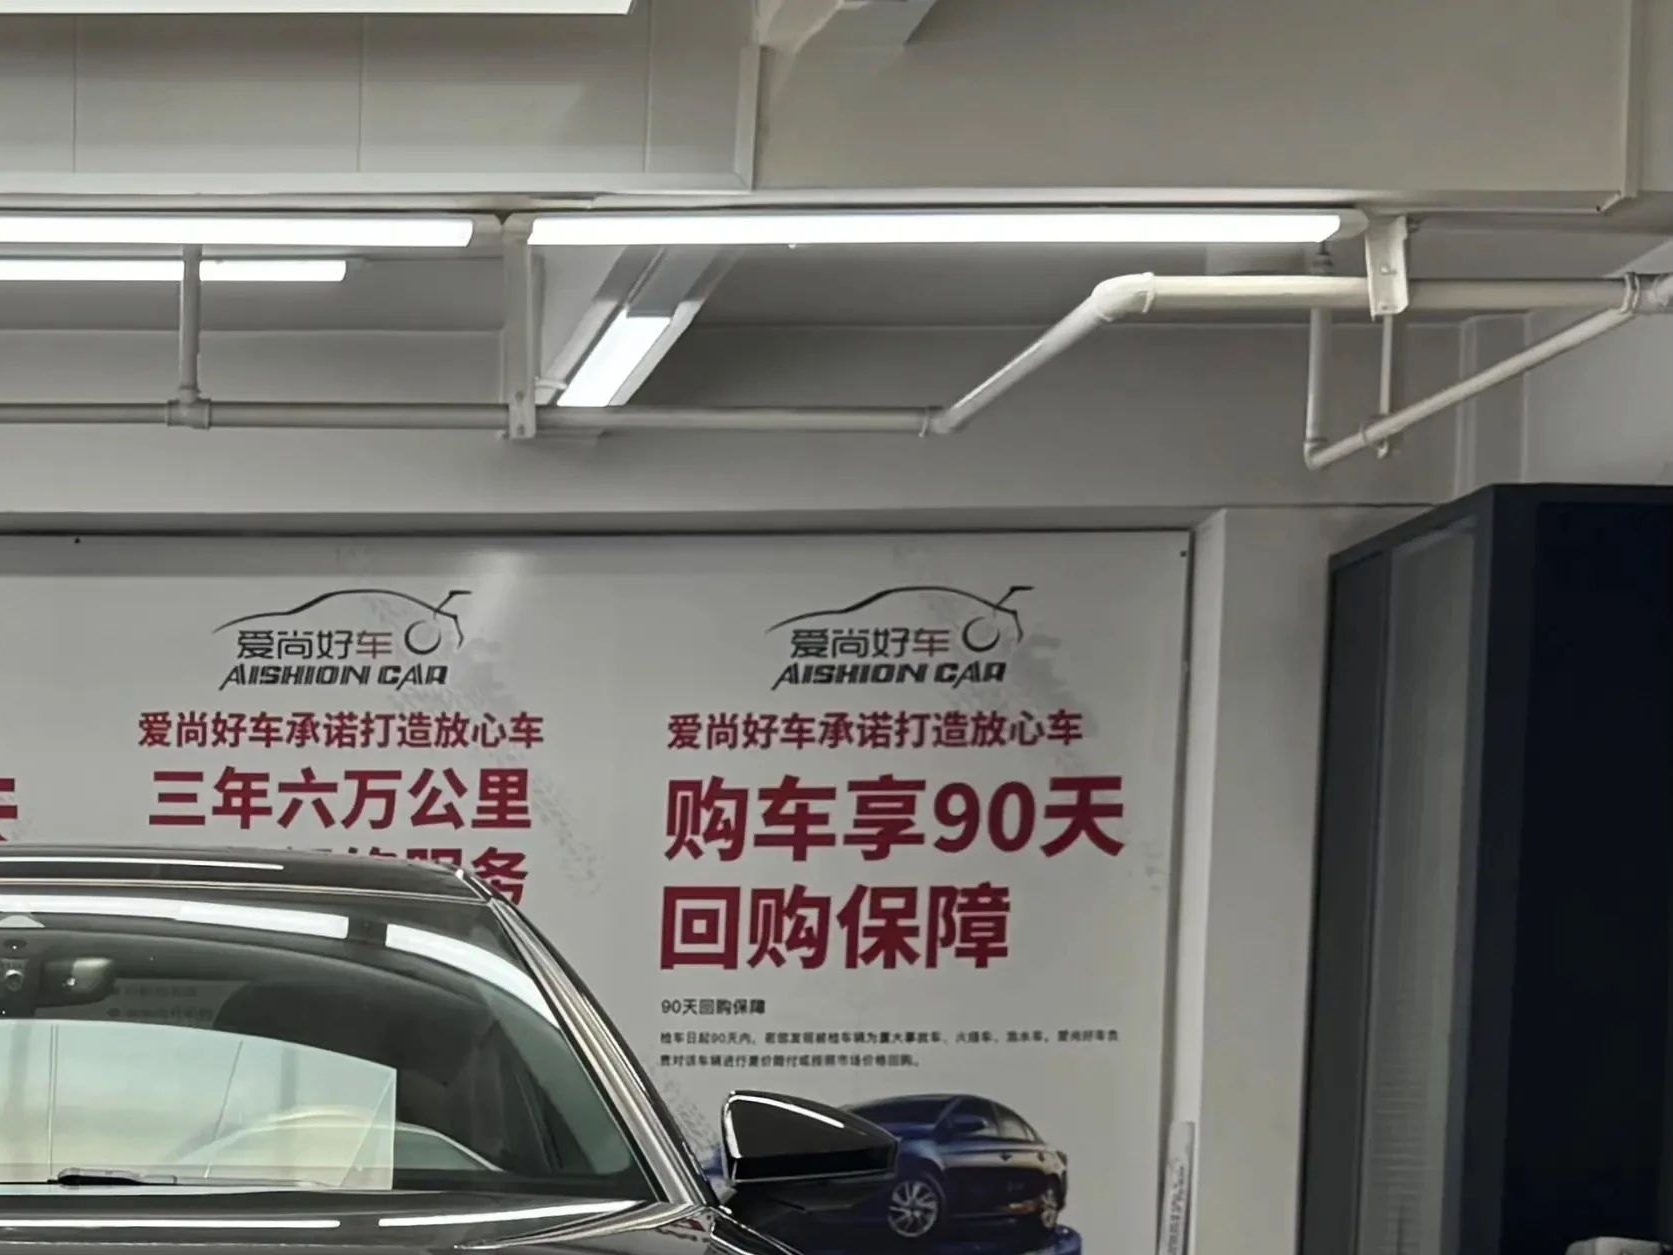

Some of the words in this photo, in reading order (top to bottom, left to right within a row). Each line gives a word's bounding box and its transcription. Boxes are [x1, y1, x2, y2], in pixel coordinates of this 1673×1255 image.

[237, 630, 393, 660] 爱尚好车
[790, 627, 952, 659] 爱尚好车
[219, 664, 371, 691] AISHION
[376, 664, 448, 691] CAR
[772, 662, 928, 691] AISHION
[932, 661, 1007, 690] CAR
[138, 711, 545, 749] 爱尚好车承诺打造放心车
[667, 709, 1084, 750] 爱尚好车承诺打造放心车
[149, 766, 532, 830] 三年六万公里
[664, 774, 1125, 861] 购车享90天
[660, 883, 1011, 970] 回购保障
[661, 997, 767, 1016] 90天回购保障
